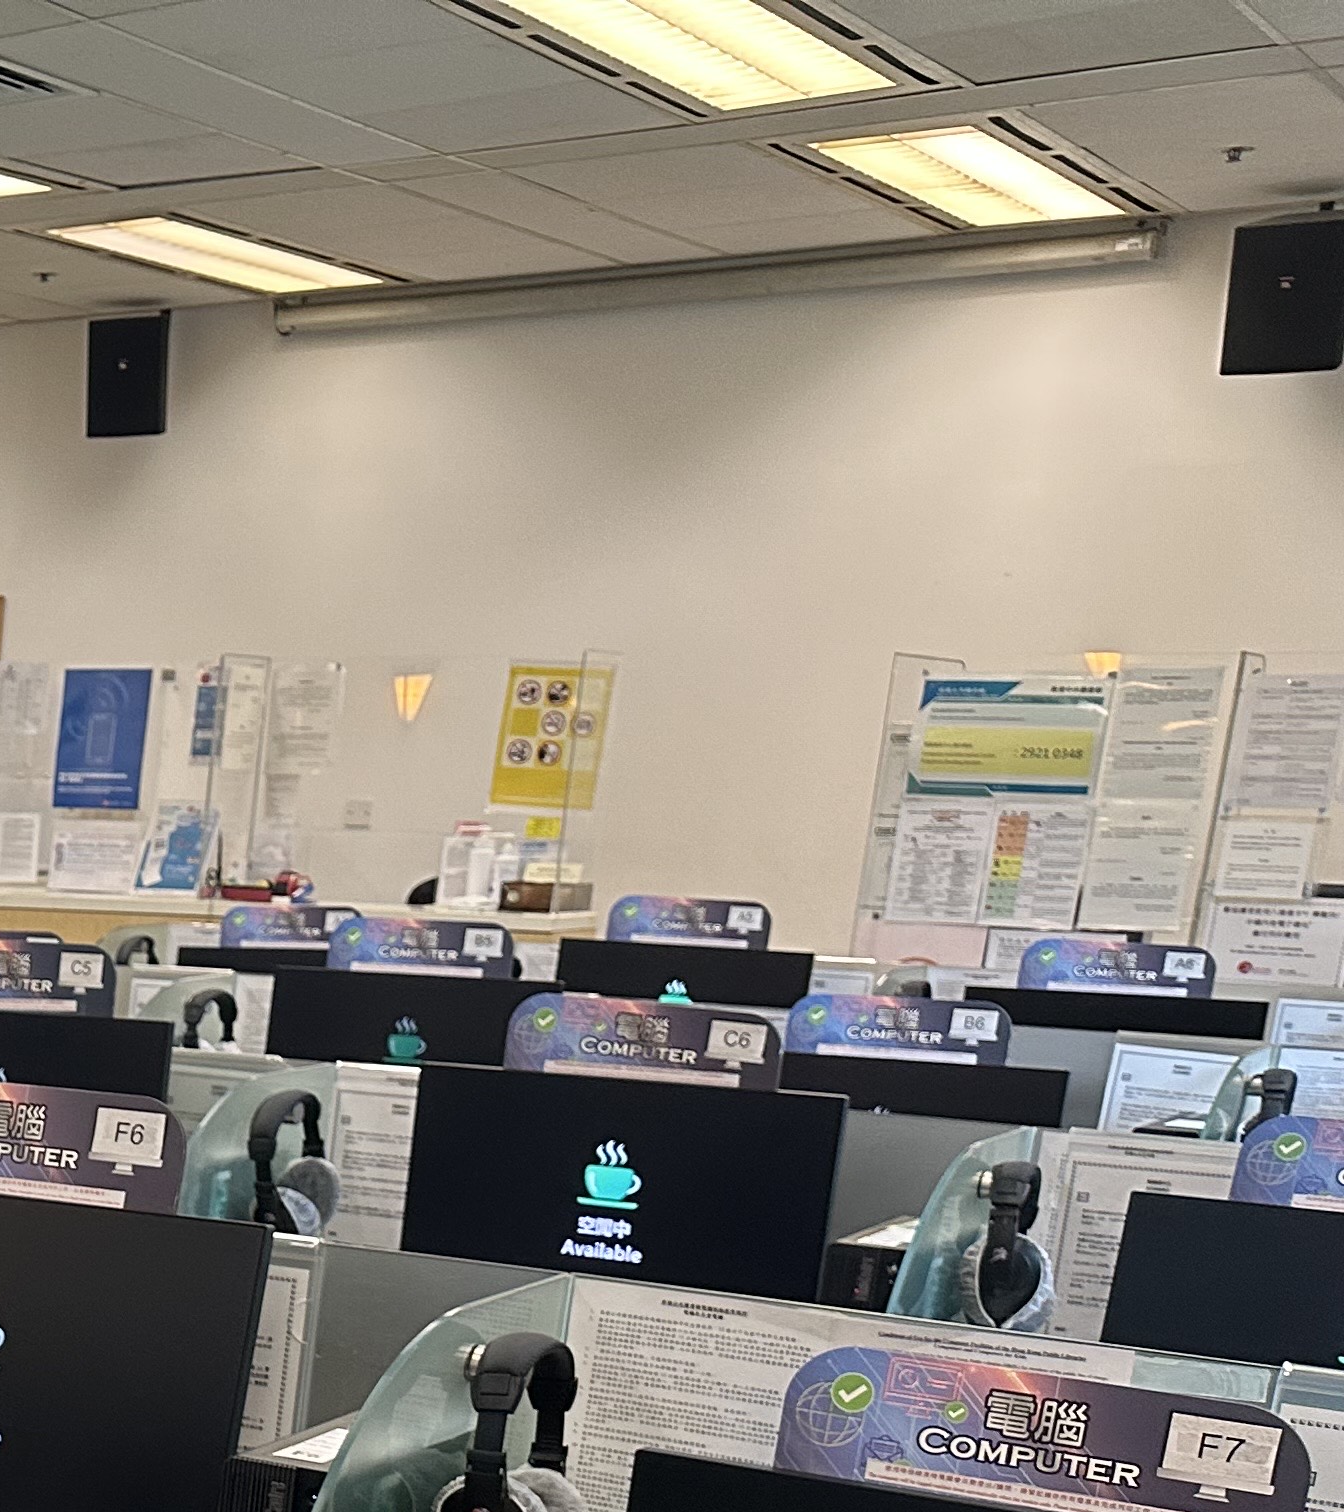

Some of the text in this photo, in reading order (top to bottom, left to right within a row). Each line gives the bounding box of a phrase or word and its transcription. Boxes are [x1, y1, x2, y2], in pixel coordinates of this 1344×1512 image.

[71, 960, 91, 976] C5
[845, 1025, 944, 1046] COMPUTER
[964, 1015, 985, 1031] B6
[579, 1036, 698, 1065] COMPUTER
[724, 1029, 751, 1049] C6
[114, 1121, 146, 1146] F6
[560, 1238, 643, 1264] Available
[985, 1390, 1088, 1448] 電腦
[917, 1426, 1141, 1488] COMPUTER
[1197, 1432, 1247, 1464] F7
